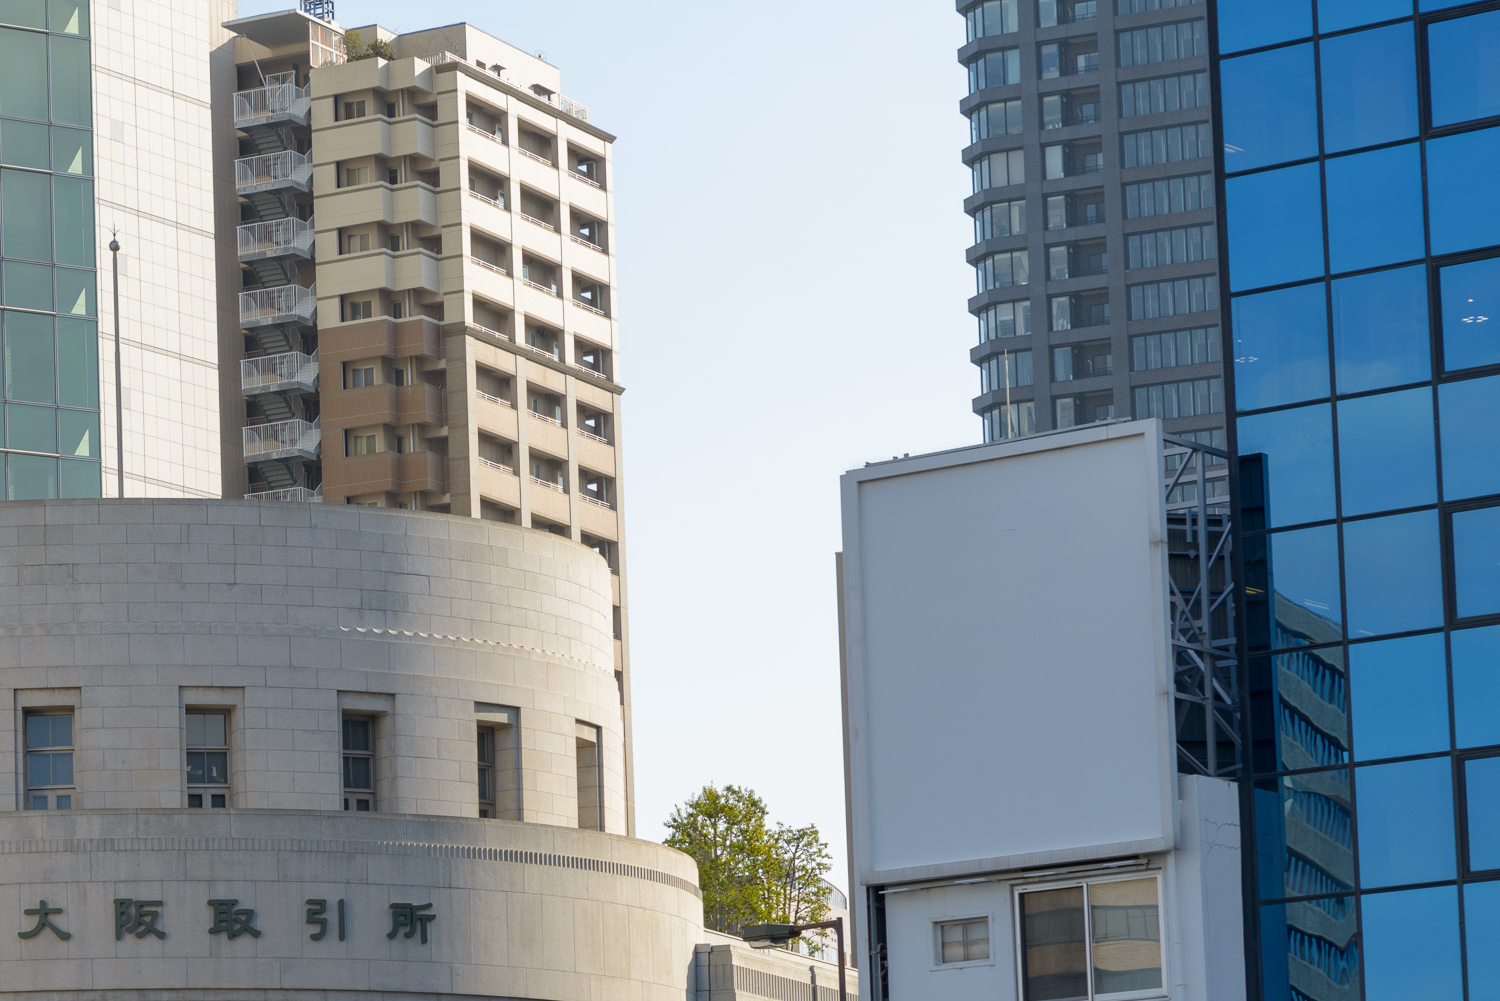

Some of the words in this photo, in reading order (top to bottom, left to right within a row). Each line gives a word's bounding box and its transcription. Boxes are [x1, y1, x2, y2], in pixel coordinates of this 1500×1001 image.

[17, 897, 437, 945] 大阪取引所
